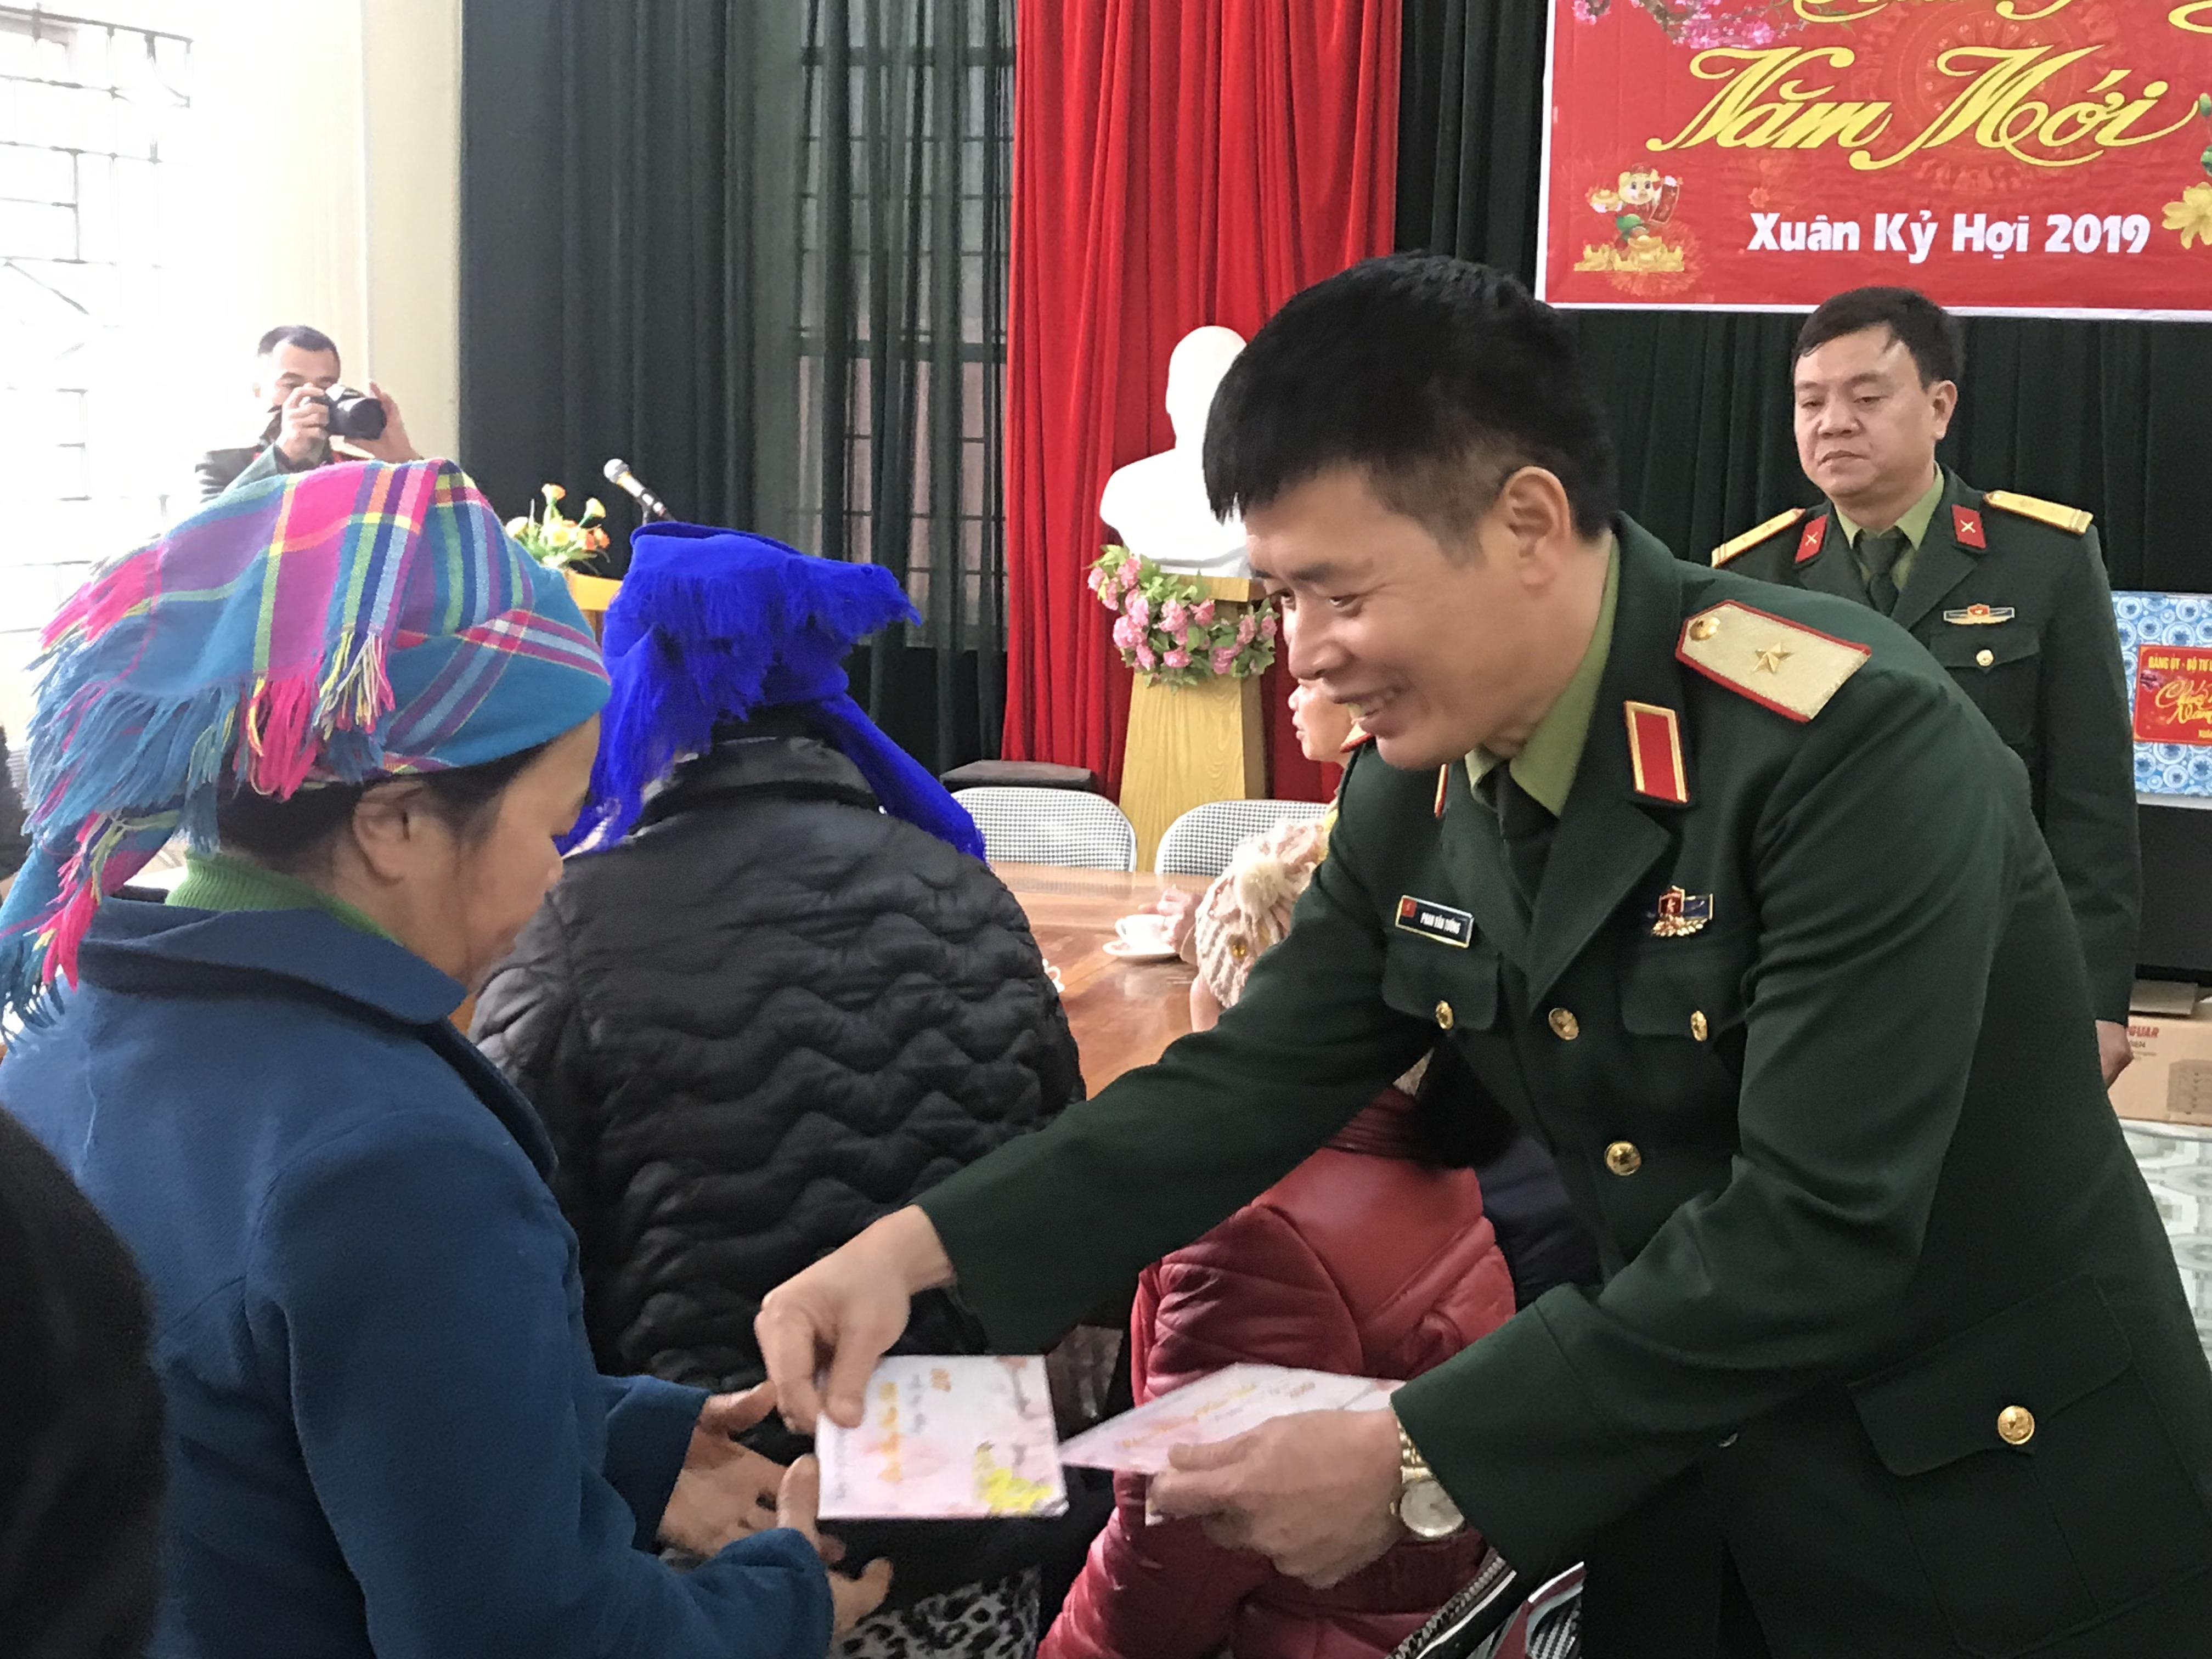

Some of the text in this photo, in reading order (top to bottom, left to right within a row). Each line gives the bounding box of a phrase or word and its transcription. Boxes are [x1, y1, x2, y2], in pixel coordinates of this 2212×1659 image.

[1646, 44, 2199, 171] Năm Mới
[1746, 210, 2151, 264] Xuân Kỷ Hợi 2019
